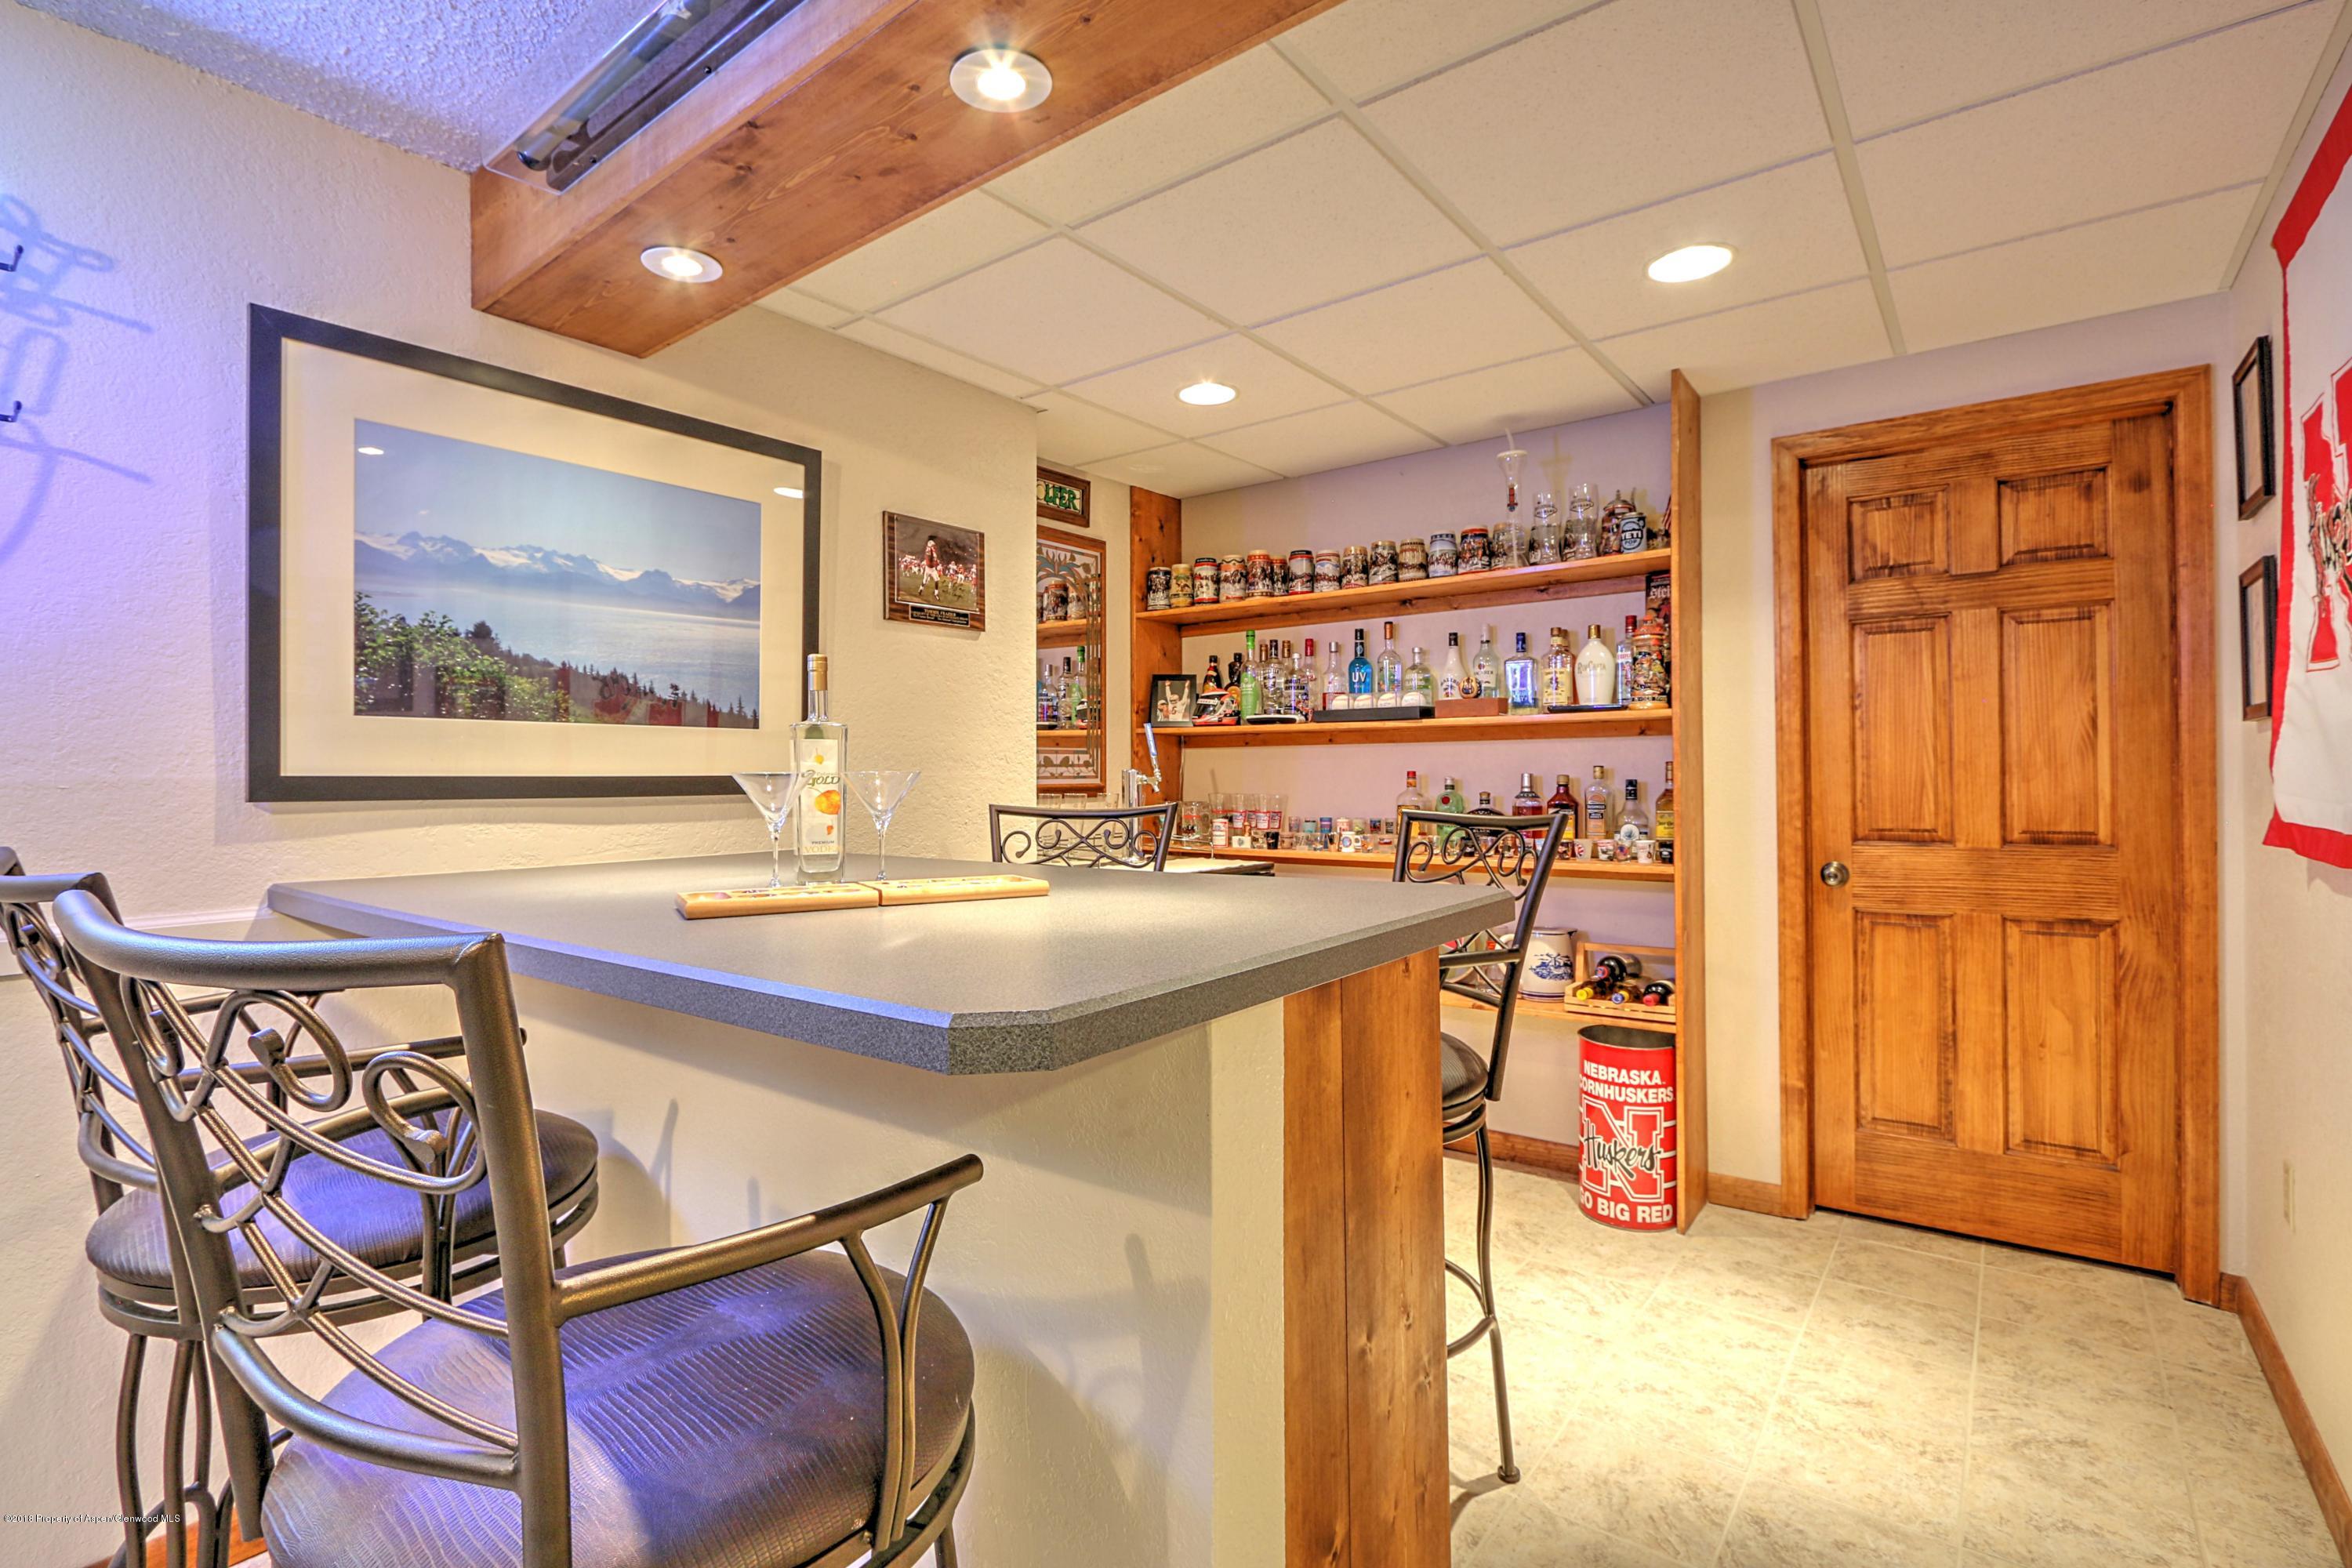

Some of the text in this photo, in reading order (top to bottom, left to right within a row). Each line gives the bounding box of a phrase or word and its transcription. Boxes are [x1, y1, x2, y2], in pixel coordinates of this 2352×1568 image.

[1036, 481, 1080, 511] OLFER
[1621, 531, 1642, 539] YETI
[1352, 672, 1367, 682] UV
[1584, 1059, 1662, 1086] NEBRASKA
[1584, 1119, 1661, 1179] Huskers
[1597, 1196, 1630, 1221] BIG
[1637, 1204, 1673, 1224] RED
